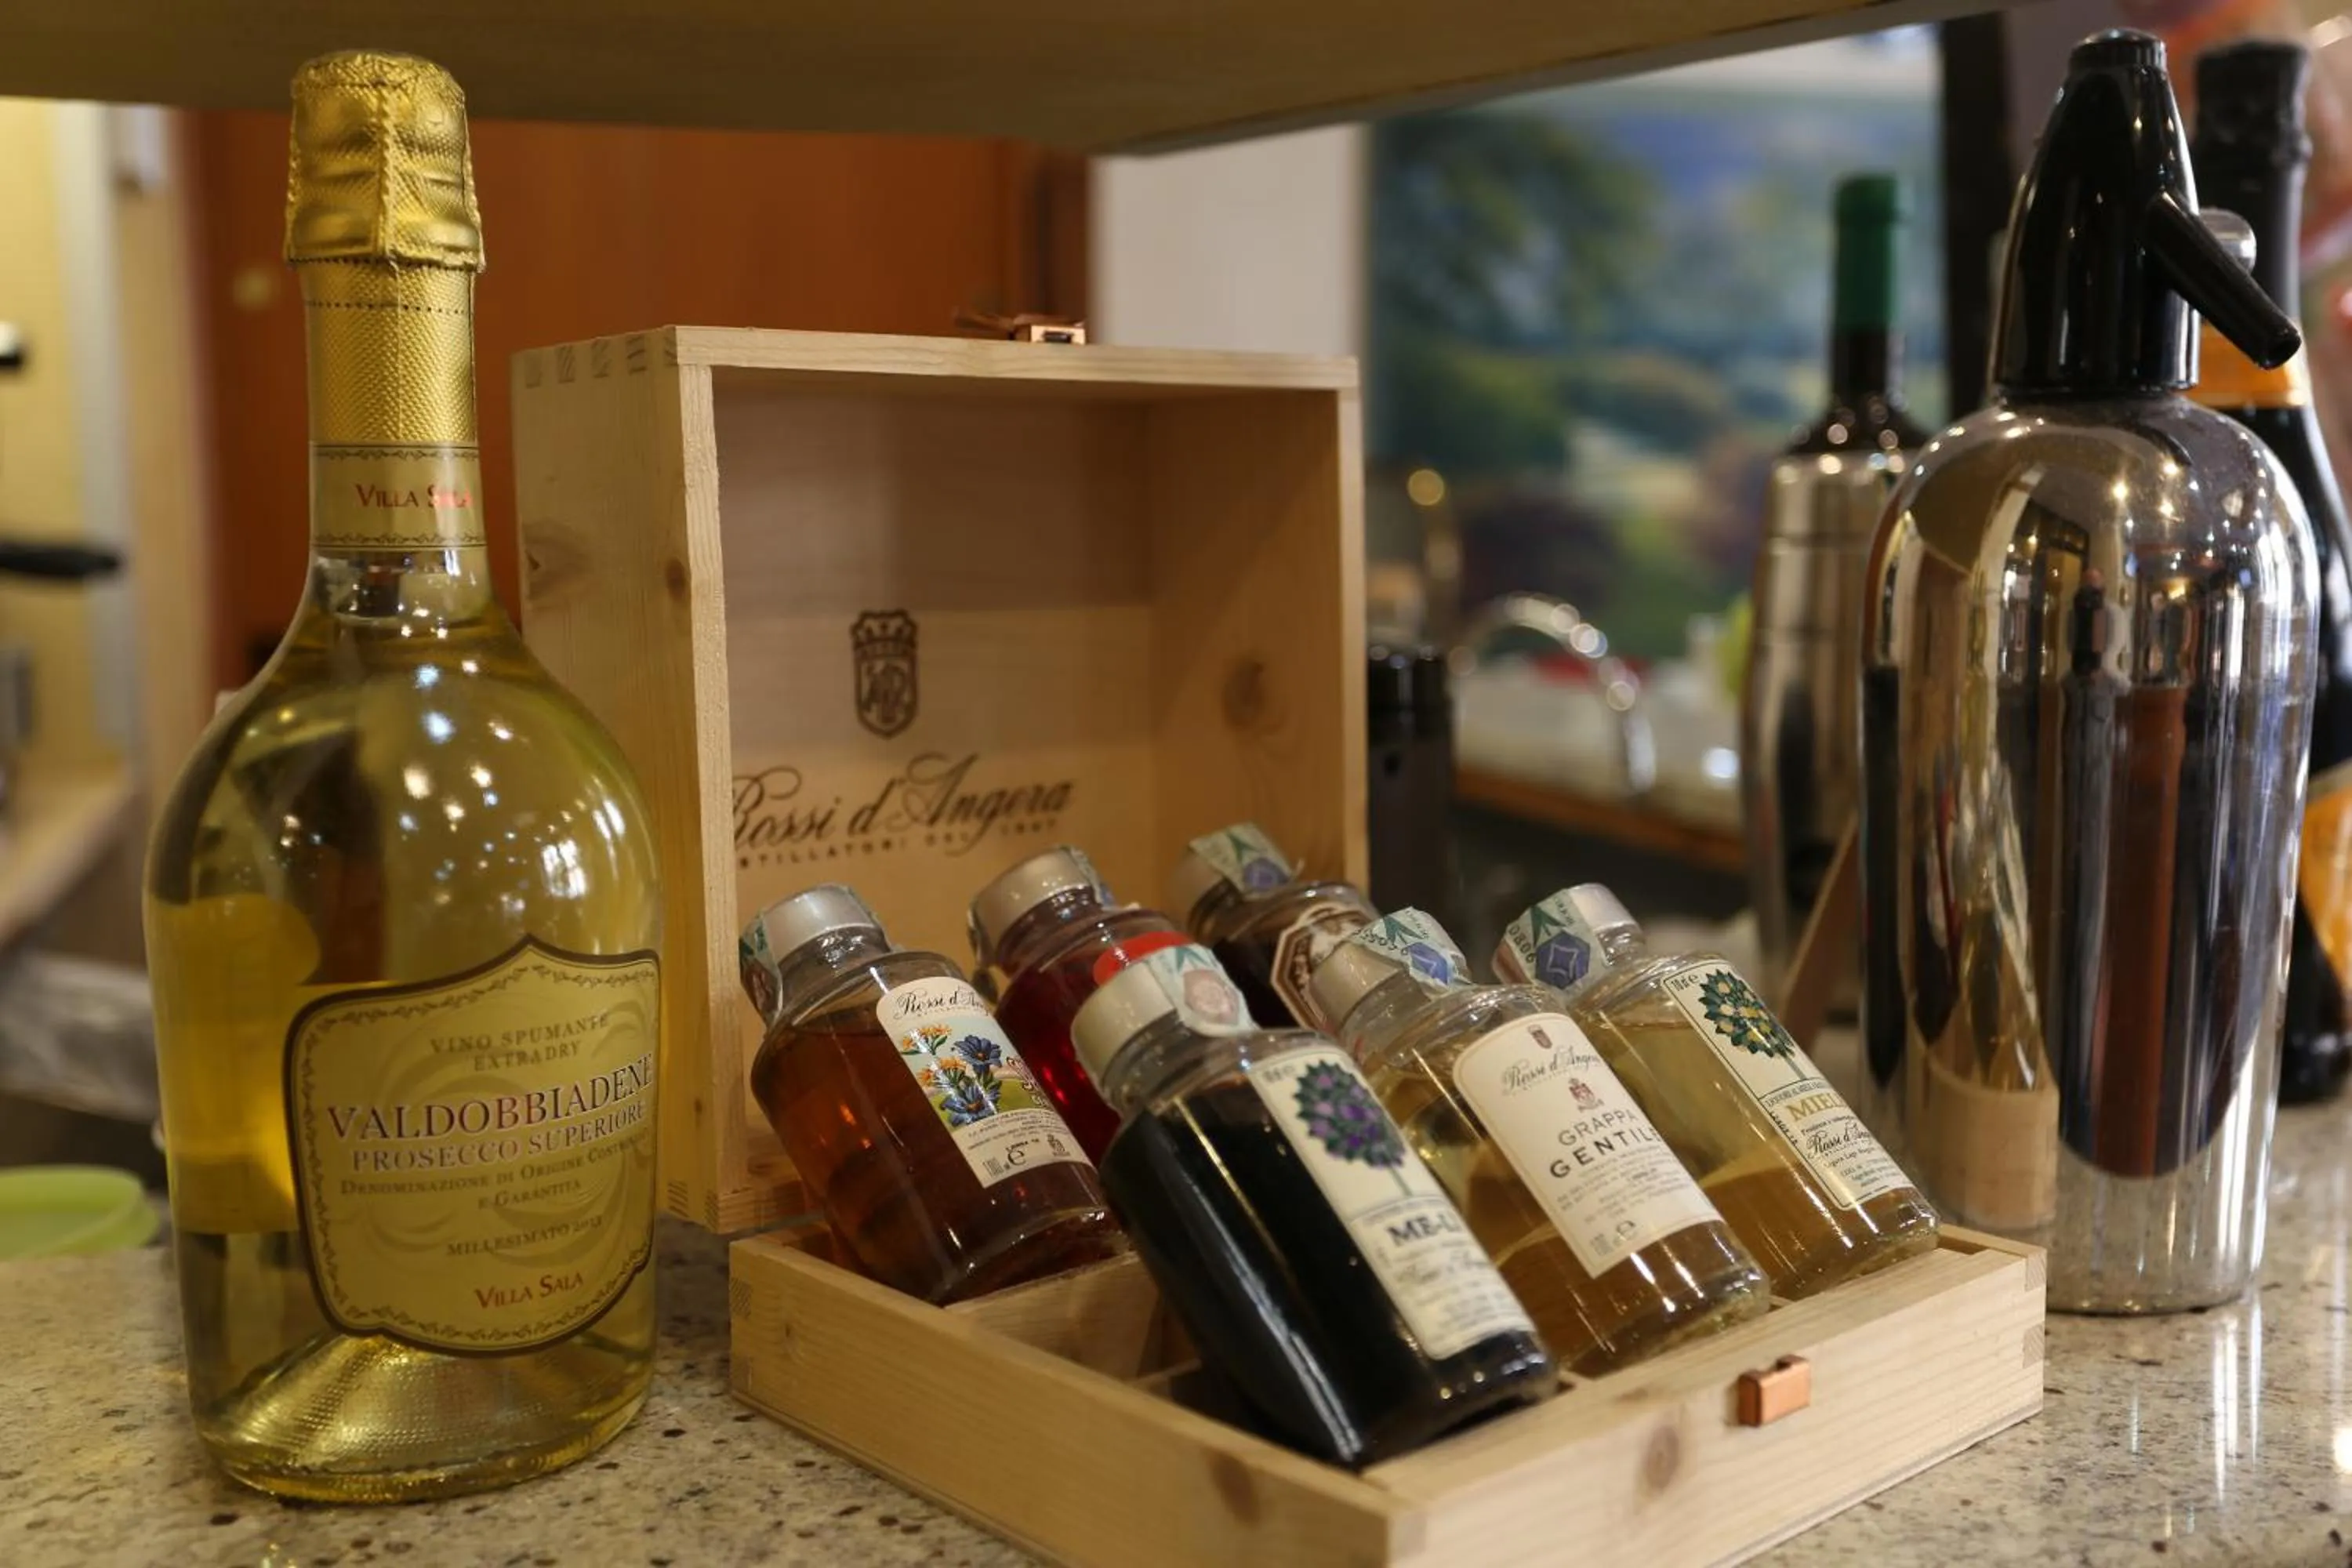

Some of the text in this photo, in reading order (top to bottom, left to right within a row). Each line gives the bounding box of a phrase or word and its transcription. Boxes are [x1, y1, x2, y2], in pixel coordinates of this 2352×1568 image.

[355, 483, 419, 509] VILLA
[430, 1013, 609, 1054] VINO SPUMANTE
[474, 1049, 543, 1072] EXTRA
[327, 1052, 653, 1141] VALDOBBIADENE
[352, 1101, 646, 1172] PROSECCO SUPERIORE
[1558, 1109, 1639, 1146] GRAPPA
[340, 1178, 489, 1196] DENOMINAZIONE
[496, 1172, 516, 1188] DI
[520, 1156, 585, 1181] ORIGINE
[445, 1223, 571, 1254] MILLESIMATO
[474, 1270, 585, 1310] VILLA SALA
